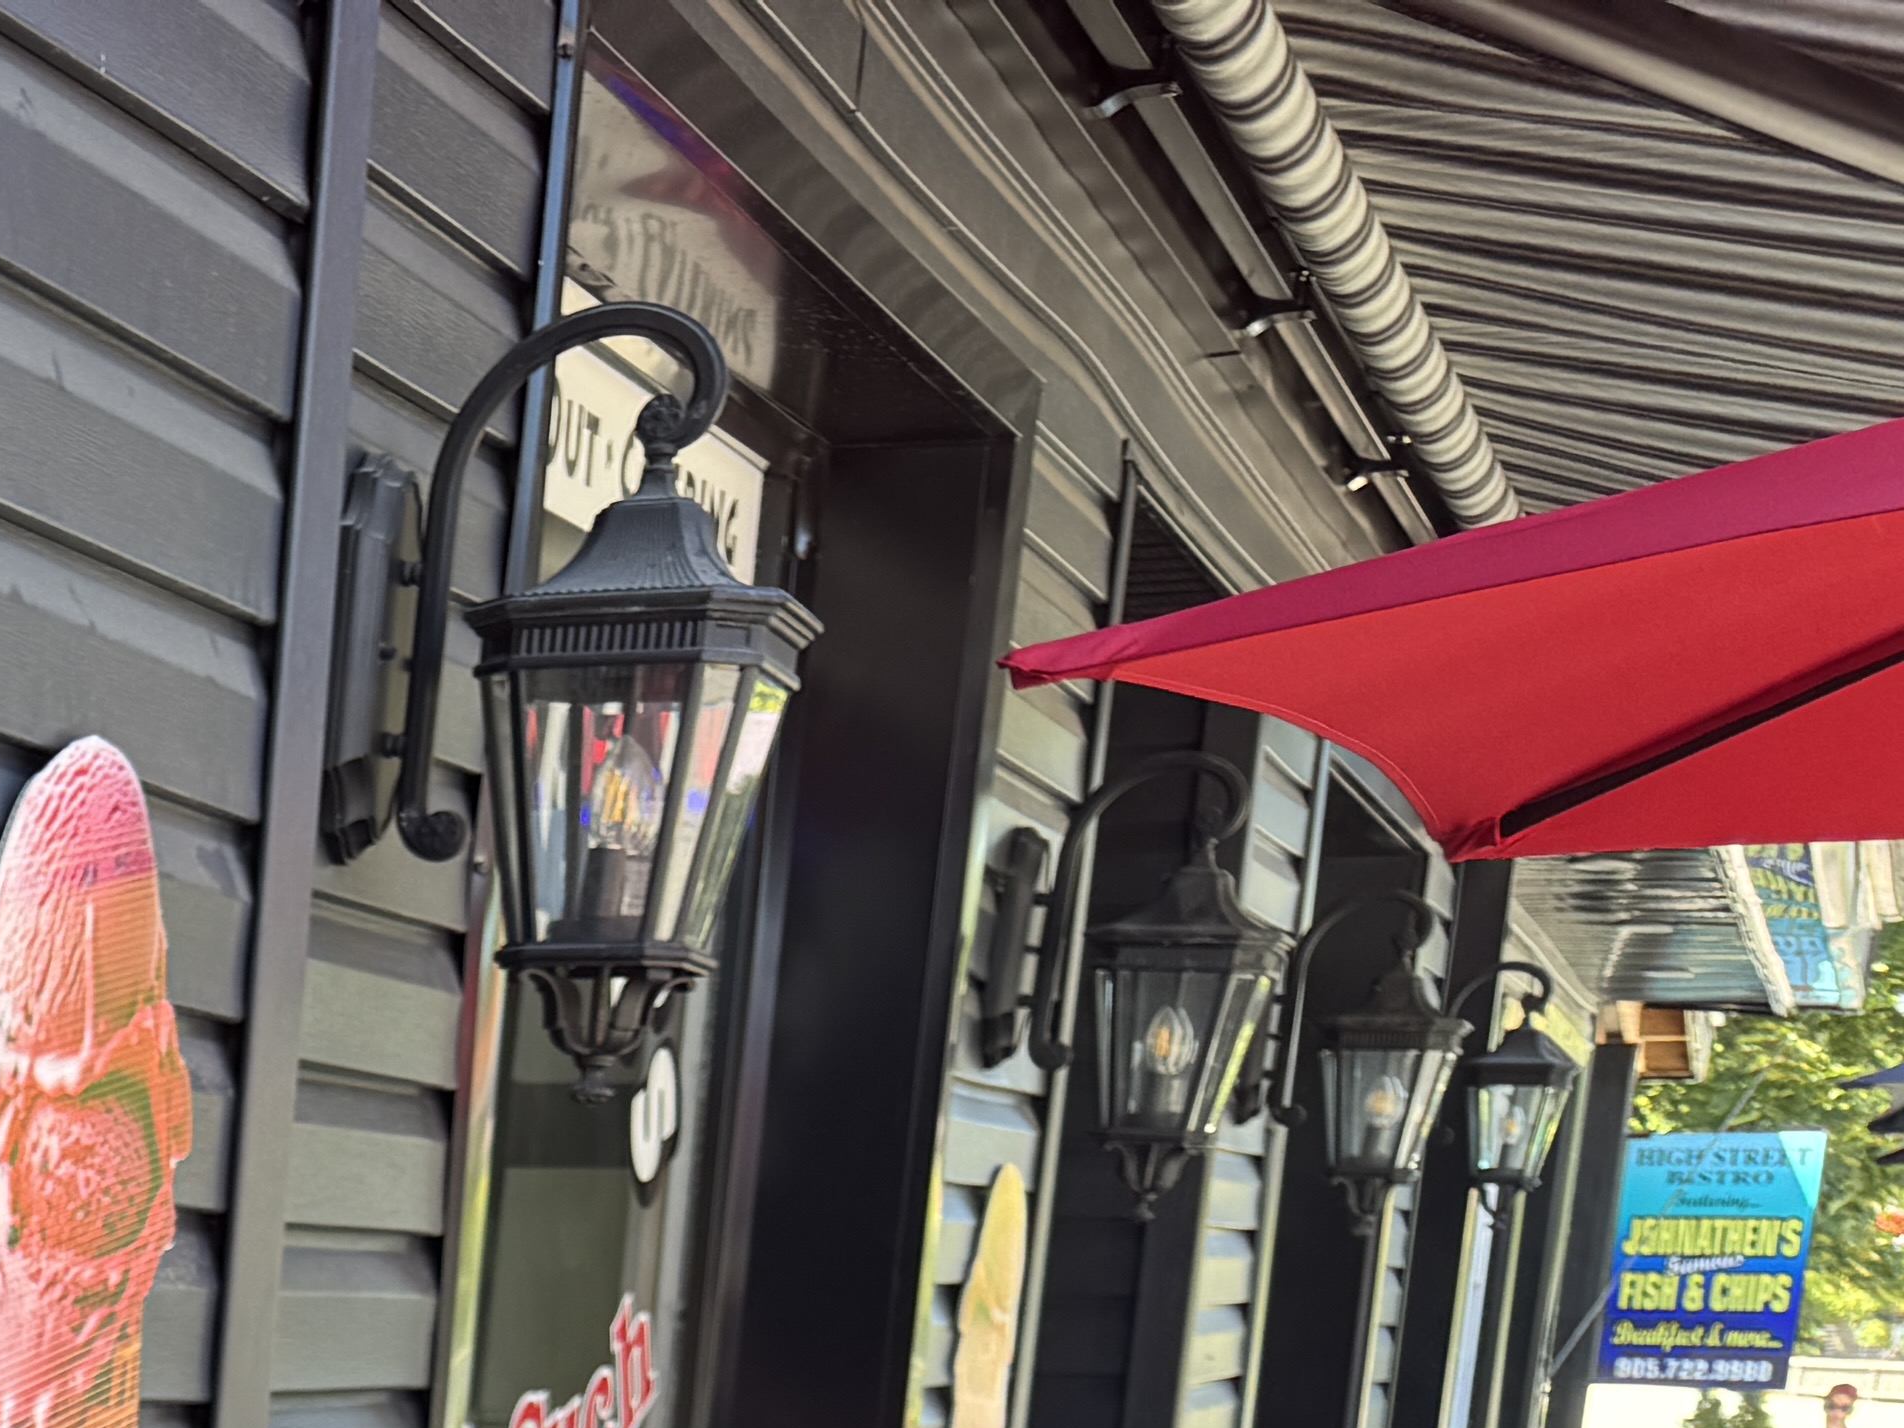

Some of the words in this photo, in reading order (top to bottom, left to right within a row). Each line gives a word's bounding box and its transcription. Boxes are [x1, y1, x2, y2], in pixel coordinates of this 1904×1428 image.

[1635, 1147, 1705, 1168] HIGH
[1617, 1272, 1680, 1311] FISH
[1681, 1273, 1705, 1312] &
[1709, 1273, 1793, 1314] CHIPS
